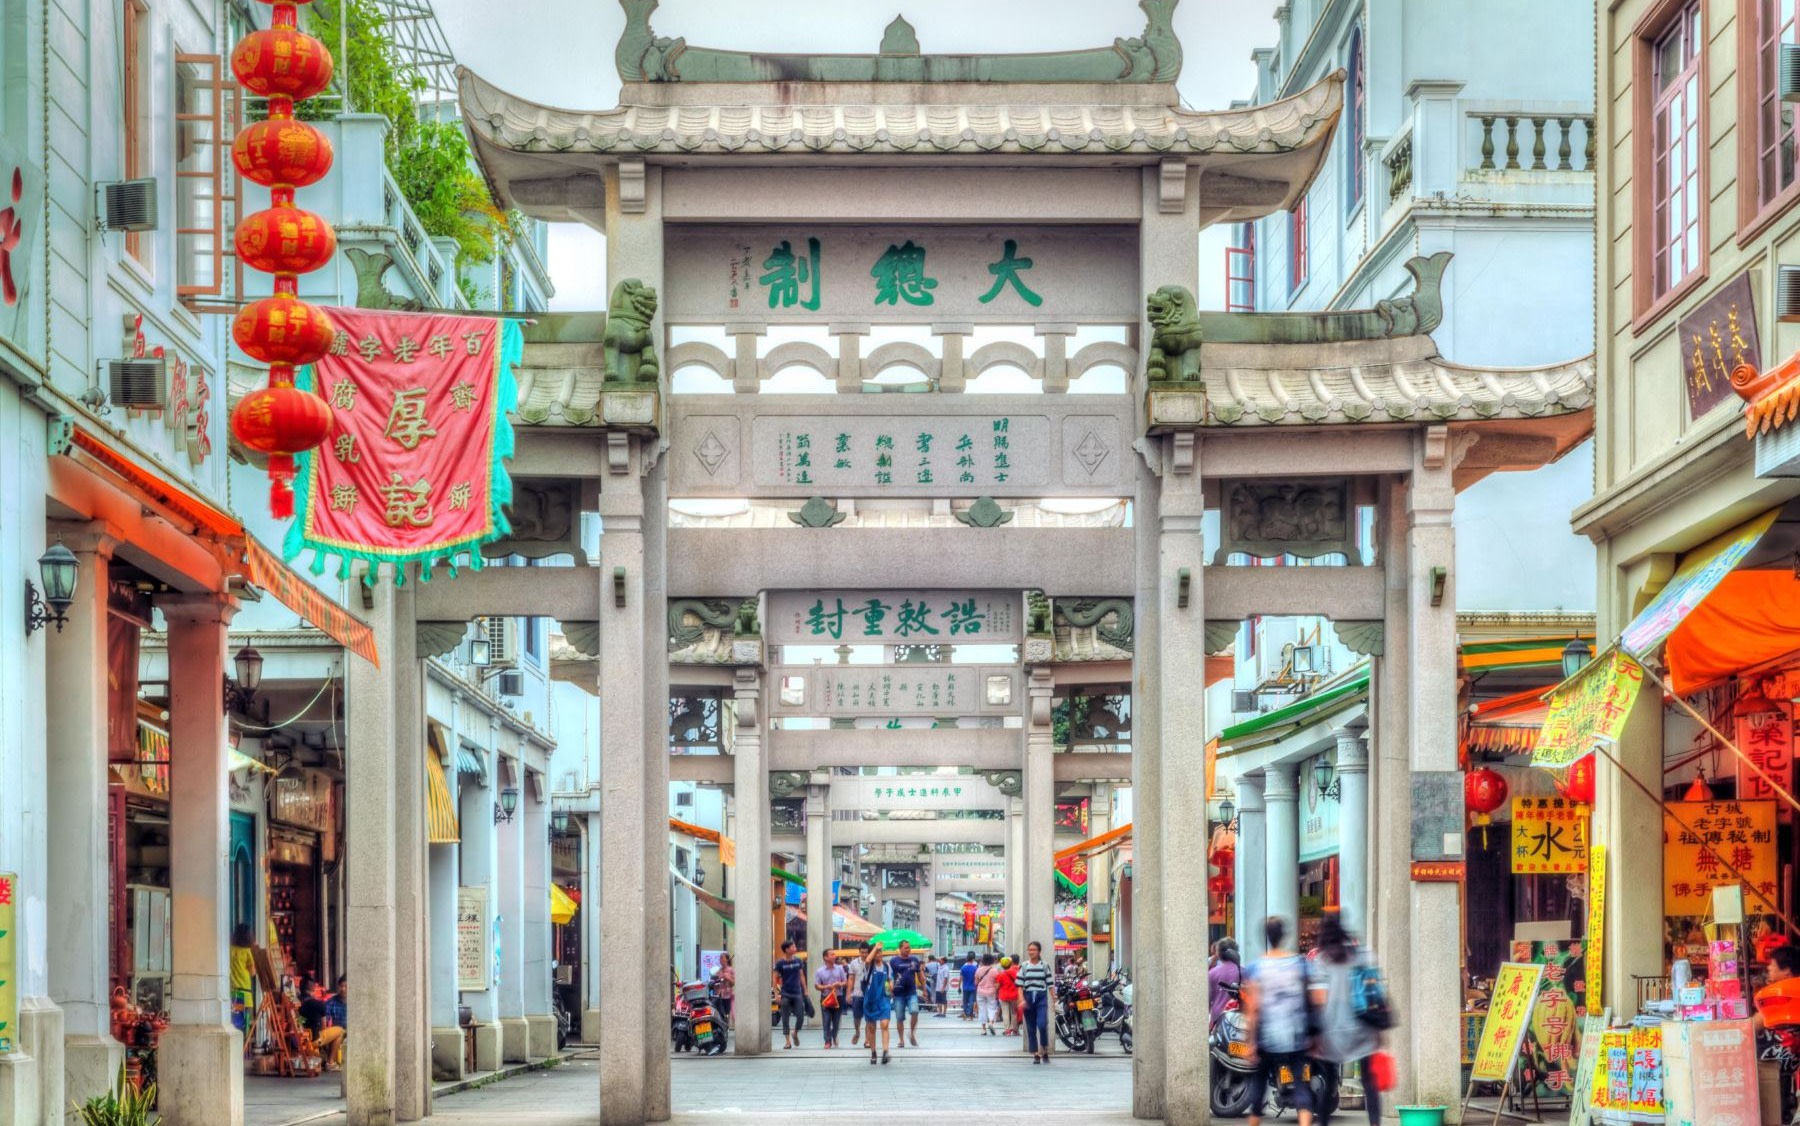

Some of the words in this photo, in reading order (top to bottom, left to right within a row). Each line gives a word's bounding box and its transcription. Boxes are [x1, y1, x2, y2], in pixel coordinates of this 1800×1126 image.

[759, 237, 1043, 311] 大總制
[383, 386, 438, 527] 厚記
[1704, 803, 1743, 815] 古城
[1530, 821, 1572, 861] 水
[1695, 846, 1754, 873] 無糖
